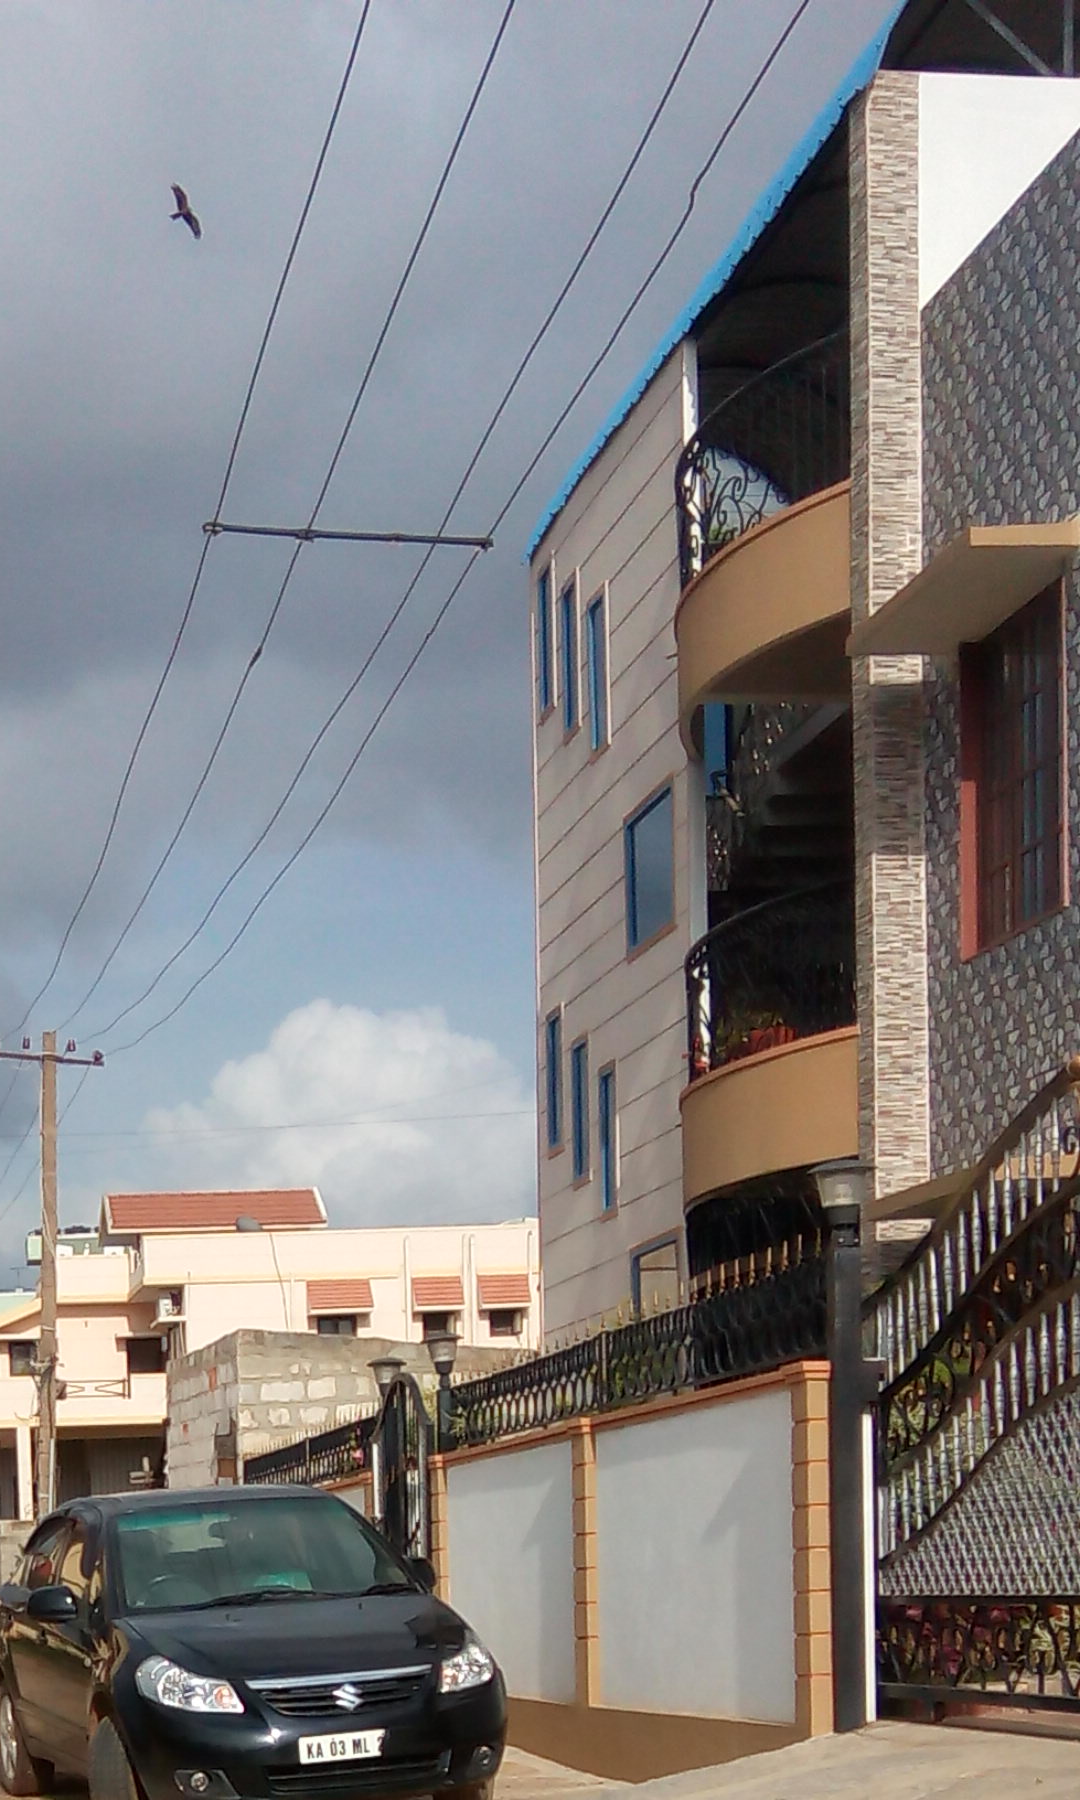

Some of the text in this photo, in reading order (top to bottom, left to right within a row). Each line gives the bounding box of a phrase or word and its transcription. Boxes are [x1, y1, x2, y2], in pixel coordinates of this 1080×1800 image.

[306, 1742, 324, 1759] KA
[330, 1740, 346, 1757] 03
[352, 1738, 370, 1755] ML
